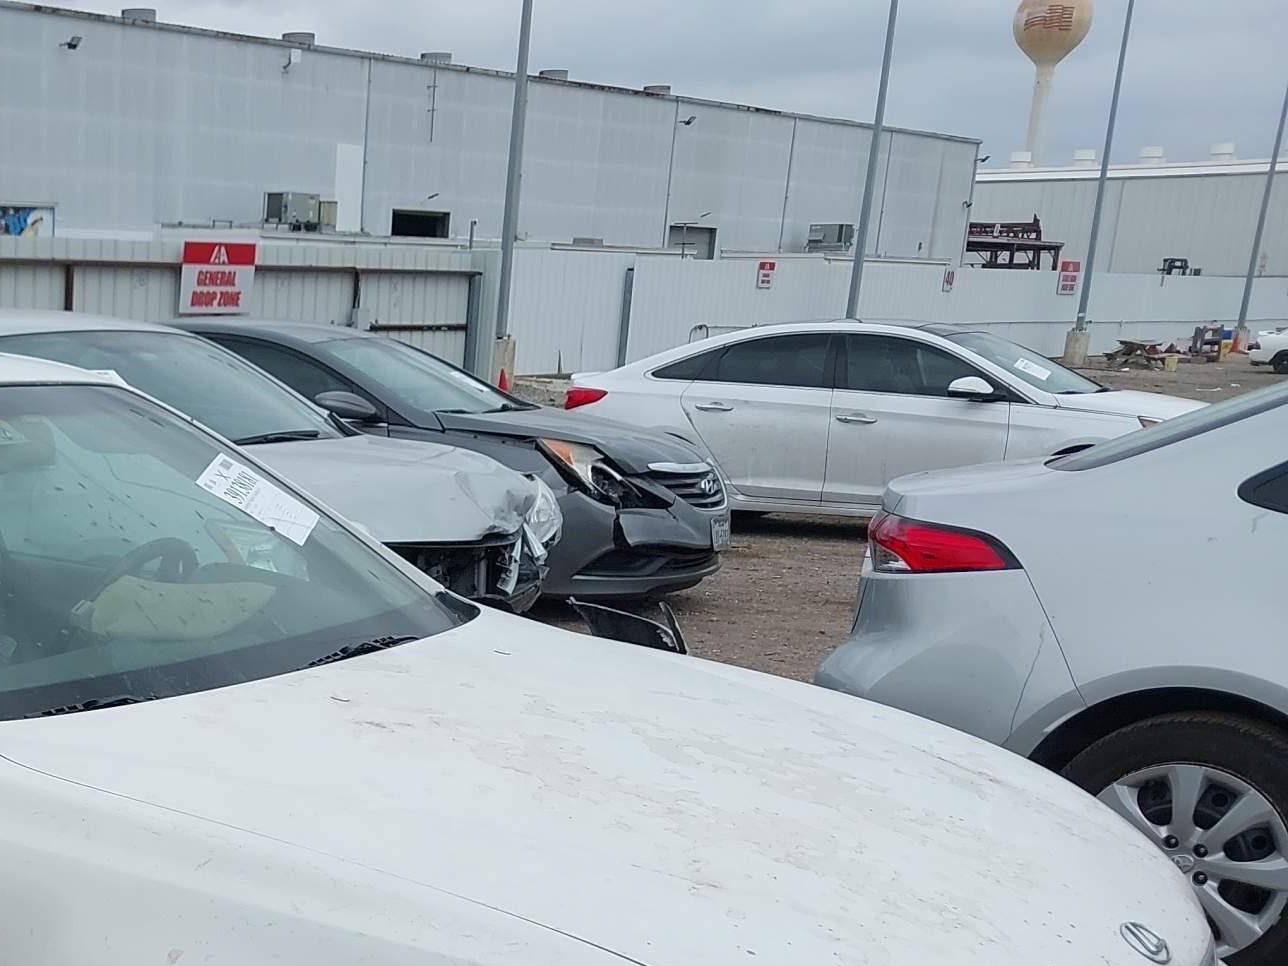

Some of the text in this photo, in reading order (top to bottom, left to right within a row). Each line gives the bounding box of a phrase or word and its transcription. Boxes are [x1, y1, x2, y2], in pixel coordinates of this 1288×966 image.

[197, 270, 236, 287] GENERAL
[190, 290, 242, 308] DROP ZONE
[223, 470, 257, 505] 39138181
